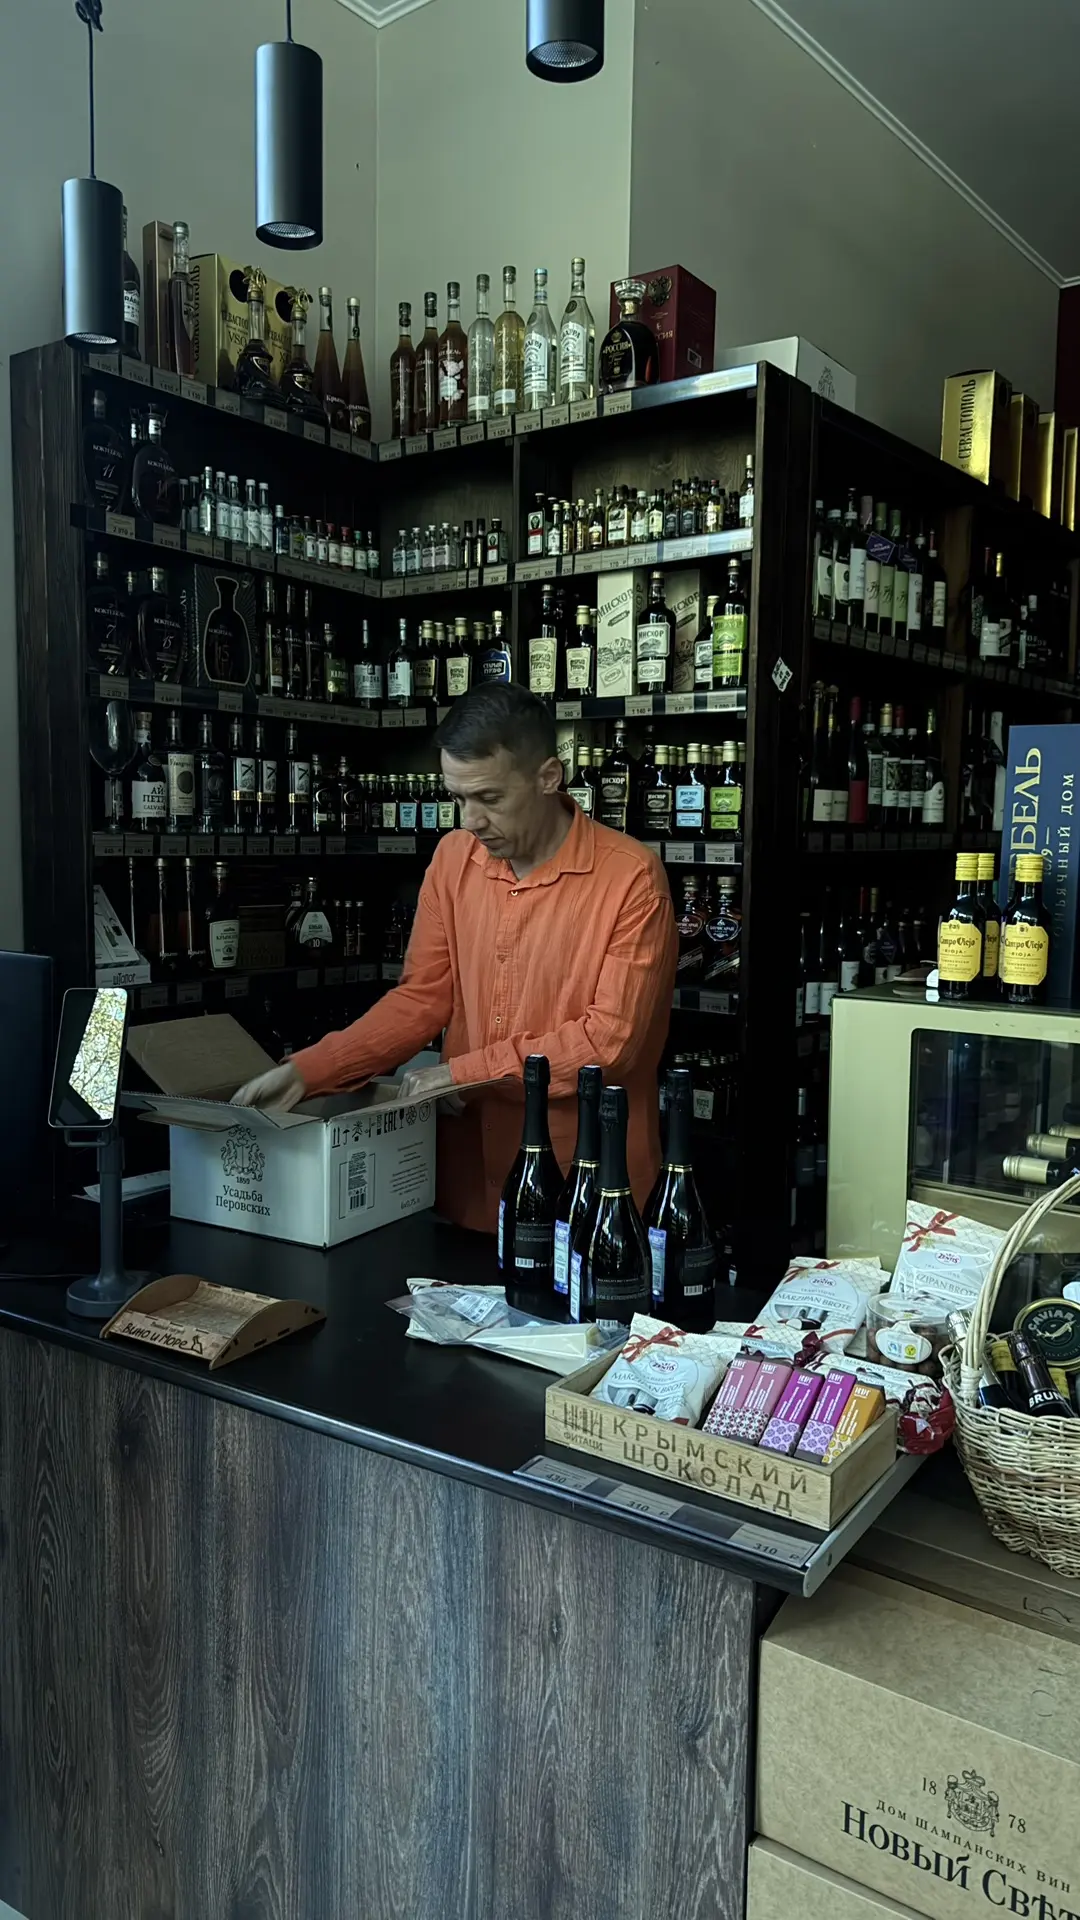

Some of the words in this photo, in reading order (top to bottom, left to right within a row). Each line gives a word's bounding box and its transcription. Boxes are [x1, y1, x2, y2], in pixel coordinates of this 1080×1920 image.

[958, 378, 977, 460] СЕВАСТОПОЛЬ
[142, 794, 166, 804] ПЕТ
[222, 1184, 263, 1203] Усадьба
[216, 1195, 271, 1217] Перовских
[777, 1293, 821, 1306] MARZIPAN
[822, 1297, 852, 1310] BROTE
[1028, 1309, 1075, 1331] CAVIAR
[613, 1416, 807, 1494] КРЫМСКИЙ
[545, 1473, 567, 1484] 430
[623, 1440, 794, 1517] ШОКОЛАД
[626, 1500, 650, 1512] 310
[752, 1542, 778, 1555] 310
[922, 1776, 938, 1796] 18
[1008, 1813, 1027, 1834] 78
